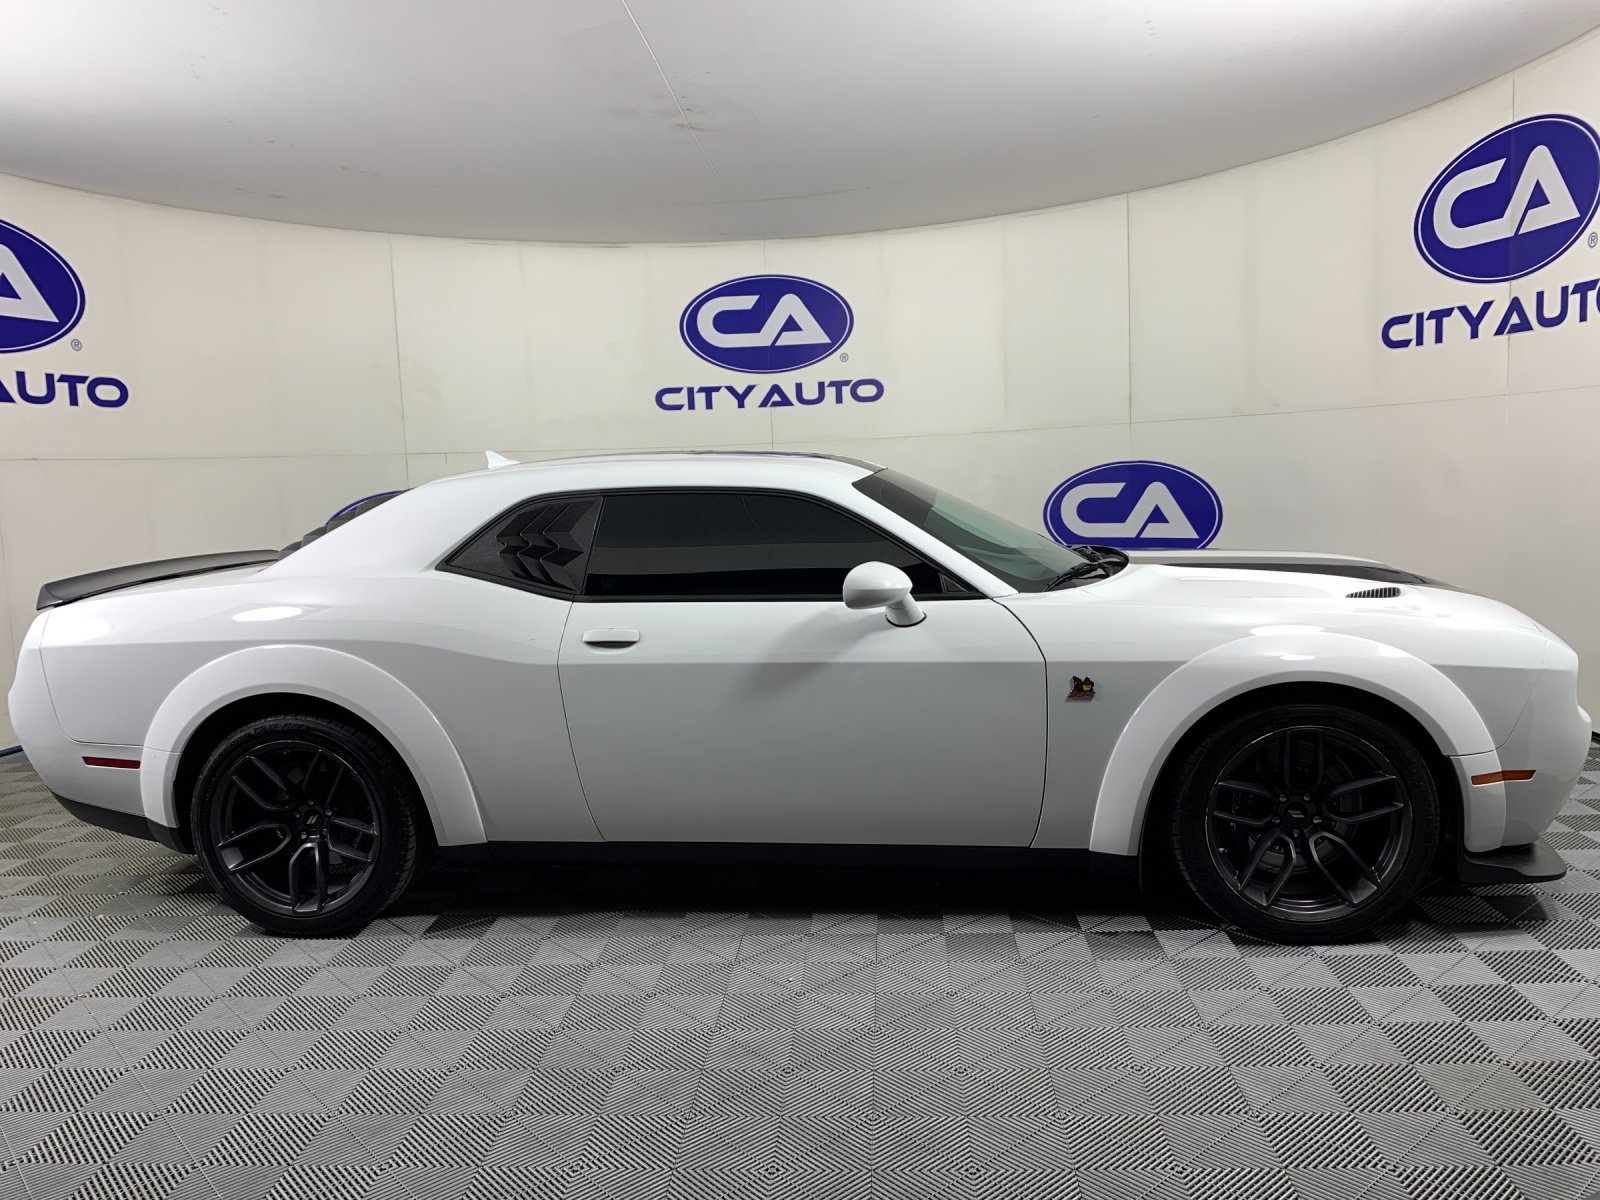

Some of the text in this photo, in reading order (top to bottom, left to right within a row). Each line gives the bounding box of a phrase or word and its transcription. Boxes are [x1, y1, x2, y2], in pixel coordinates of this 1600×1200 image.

[1433, 144, 1581, 249] CA
[696, 293, 832, 348] CA
[1493, 278, 1600, 336] AUT
[1060, 481, 1200, 539] CA
